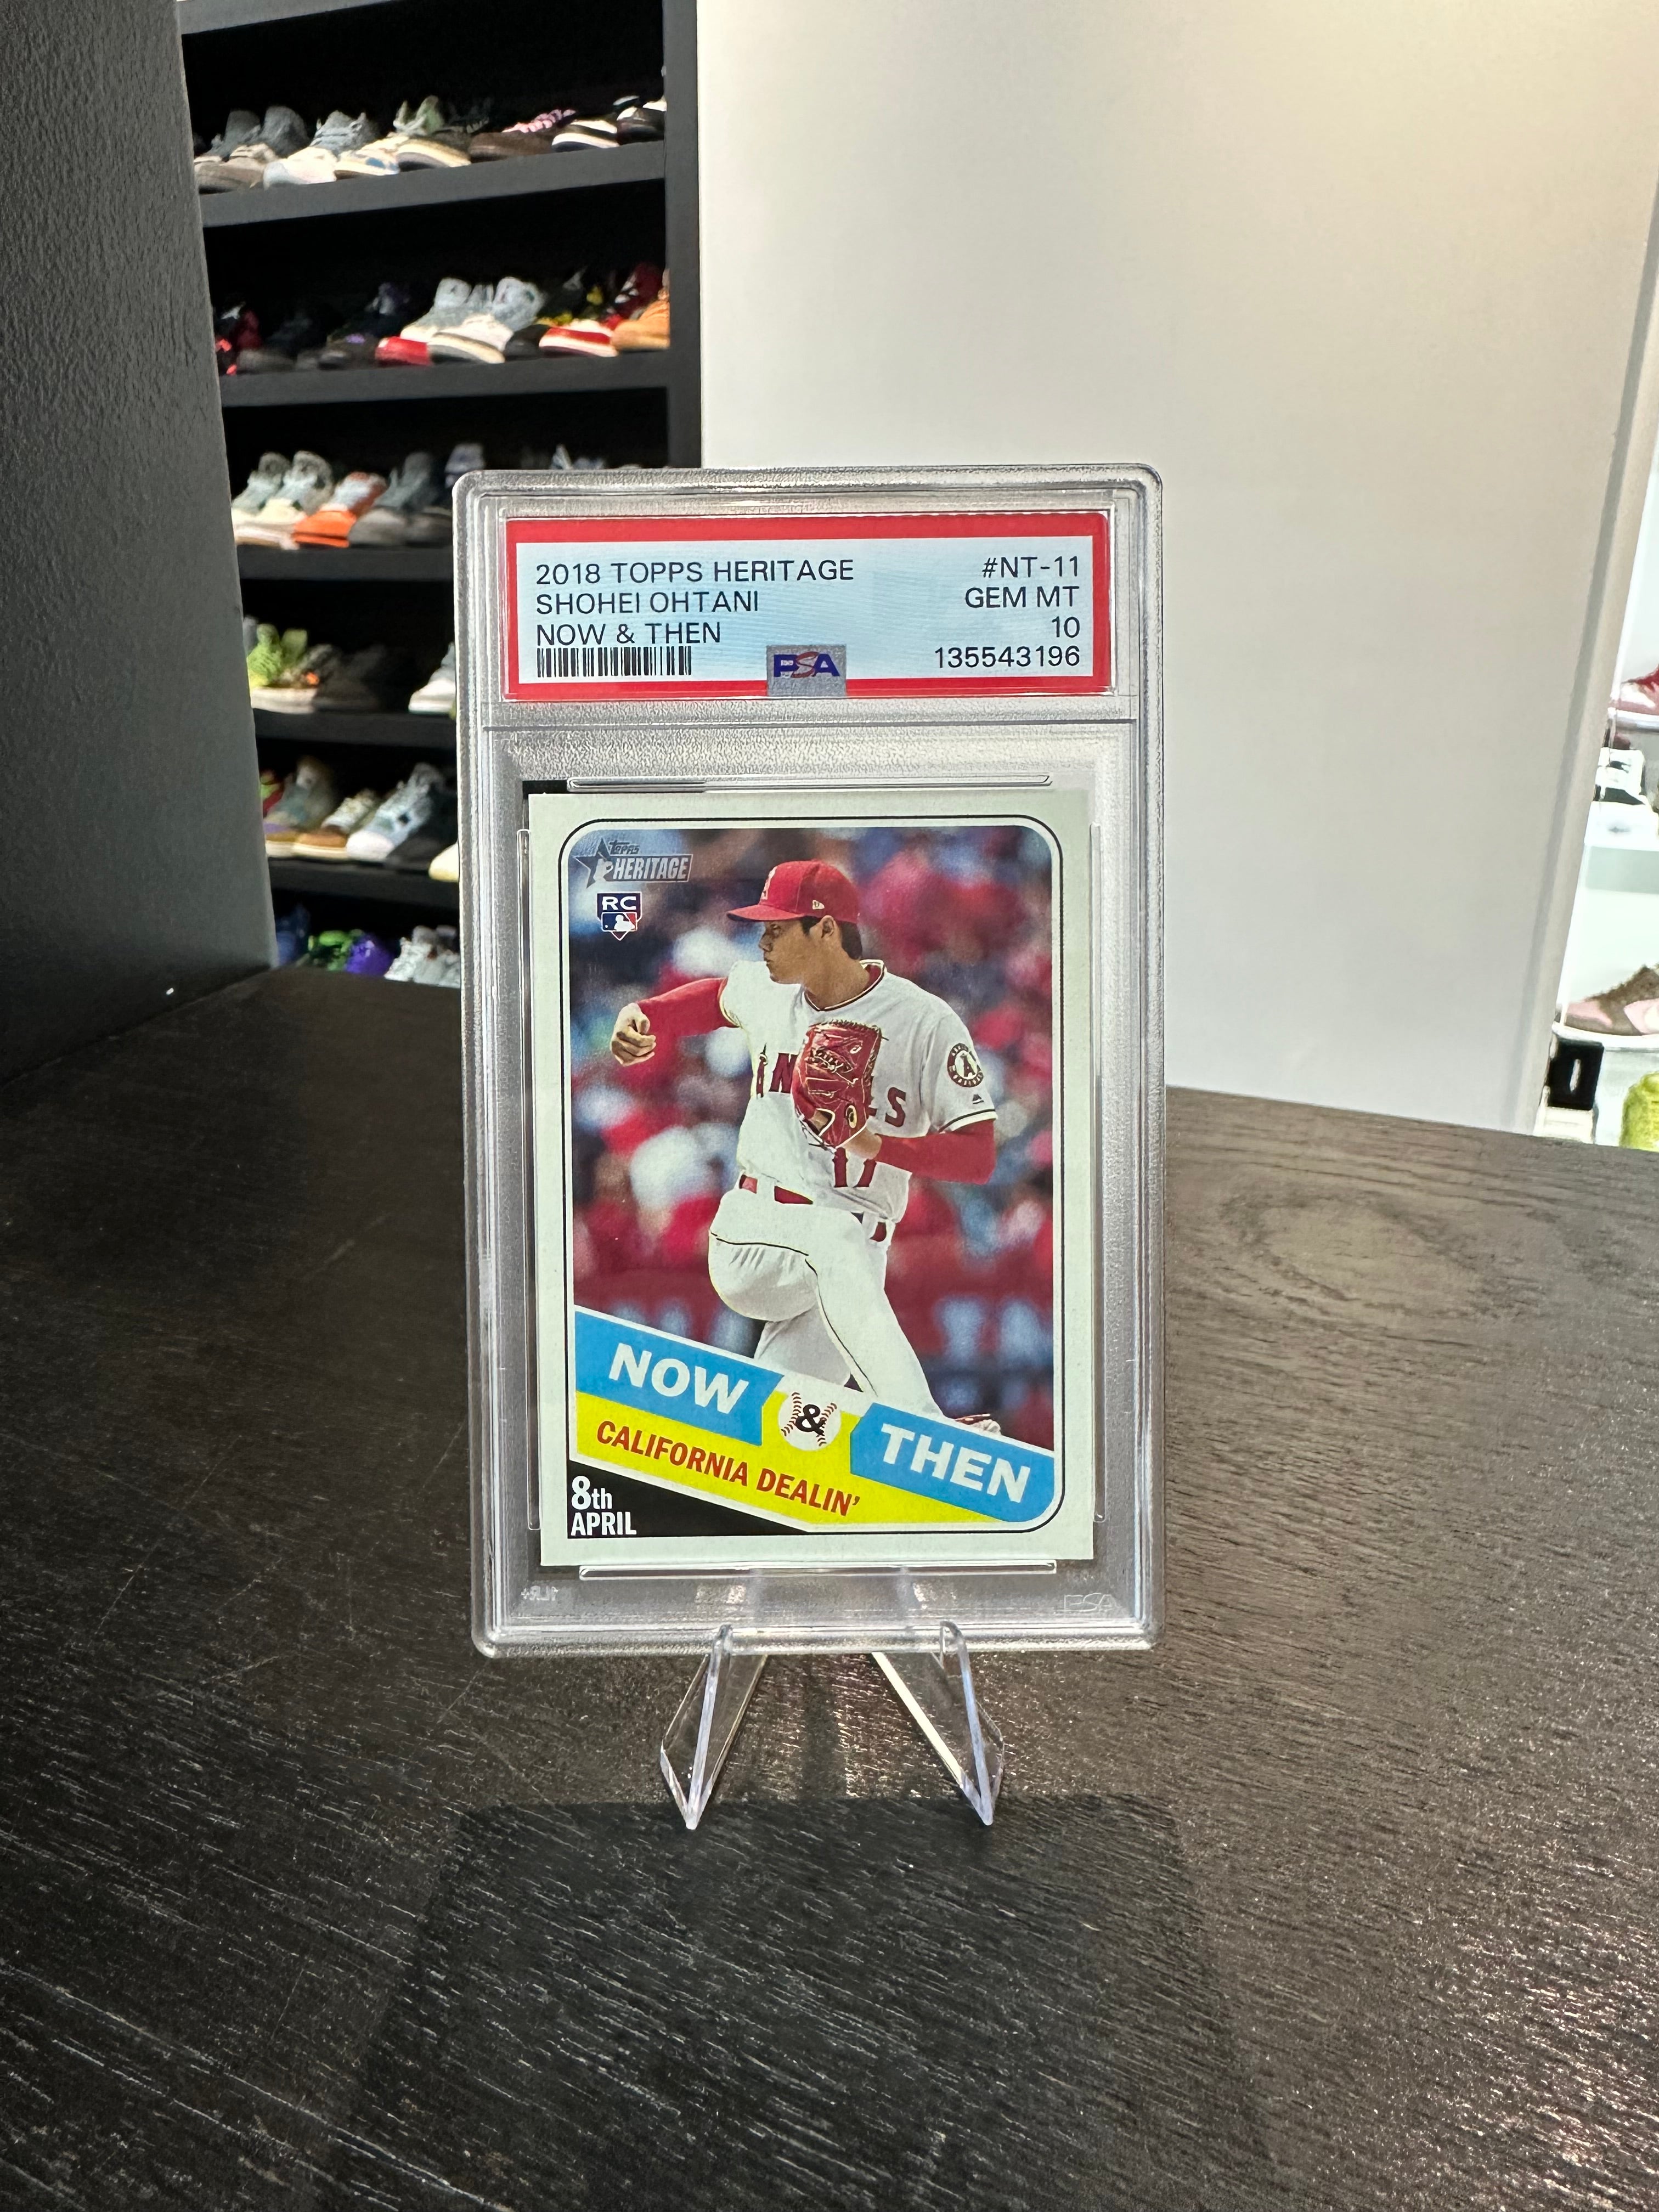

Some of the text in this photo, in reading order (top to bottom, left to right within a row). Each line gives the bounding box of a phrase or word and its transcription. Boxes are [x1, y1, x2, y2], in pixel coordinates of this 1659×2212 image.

[536, 559, 854, 585] 2018 TOPPS HERITAGE
[982, 556, 1078, 578] #NT-11
[536, 590, 758, 615] SHOHEI OHTANI
[965, 585, 1080, 608] GEM MT
[537, 622, 720, 646] NOW & THEN
[1052, 616, 1080, 638] 10
[773, 651, 840, 678] PSA
[935, 645, 1080, 668] 135543196
[612, 857, 689, 880] HERITAGE
[602, 895, 637, 911] RC
[608, 1342, 1031, 1503] NOW & THEN
[596, 1420, 861, 1516] CALIFORNIA DEALIN'
[571, 1475, 613, 1510] 8th
[571, 1511, 637, 1536] APRIL
